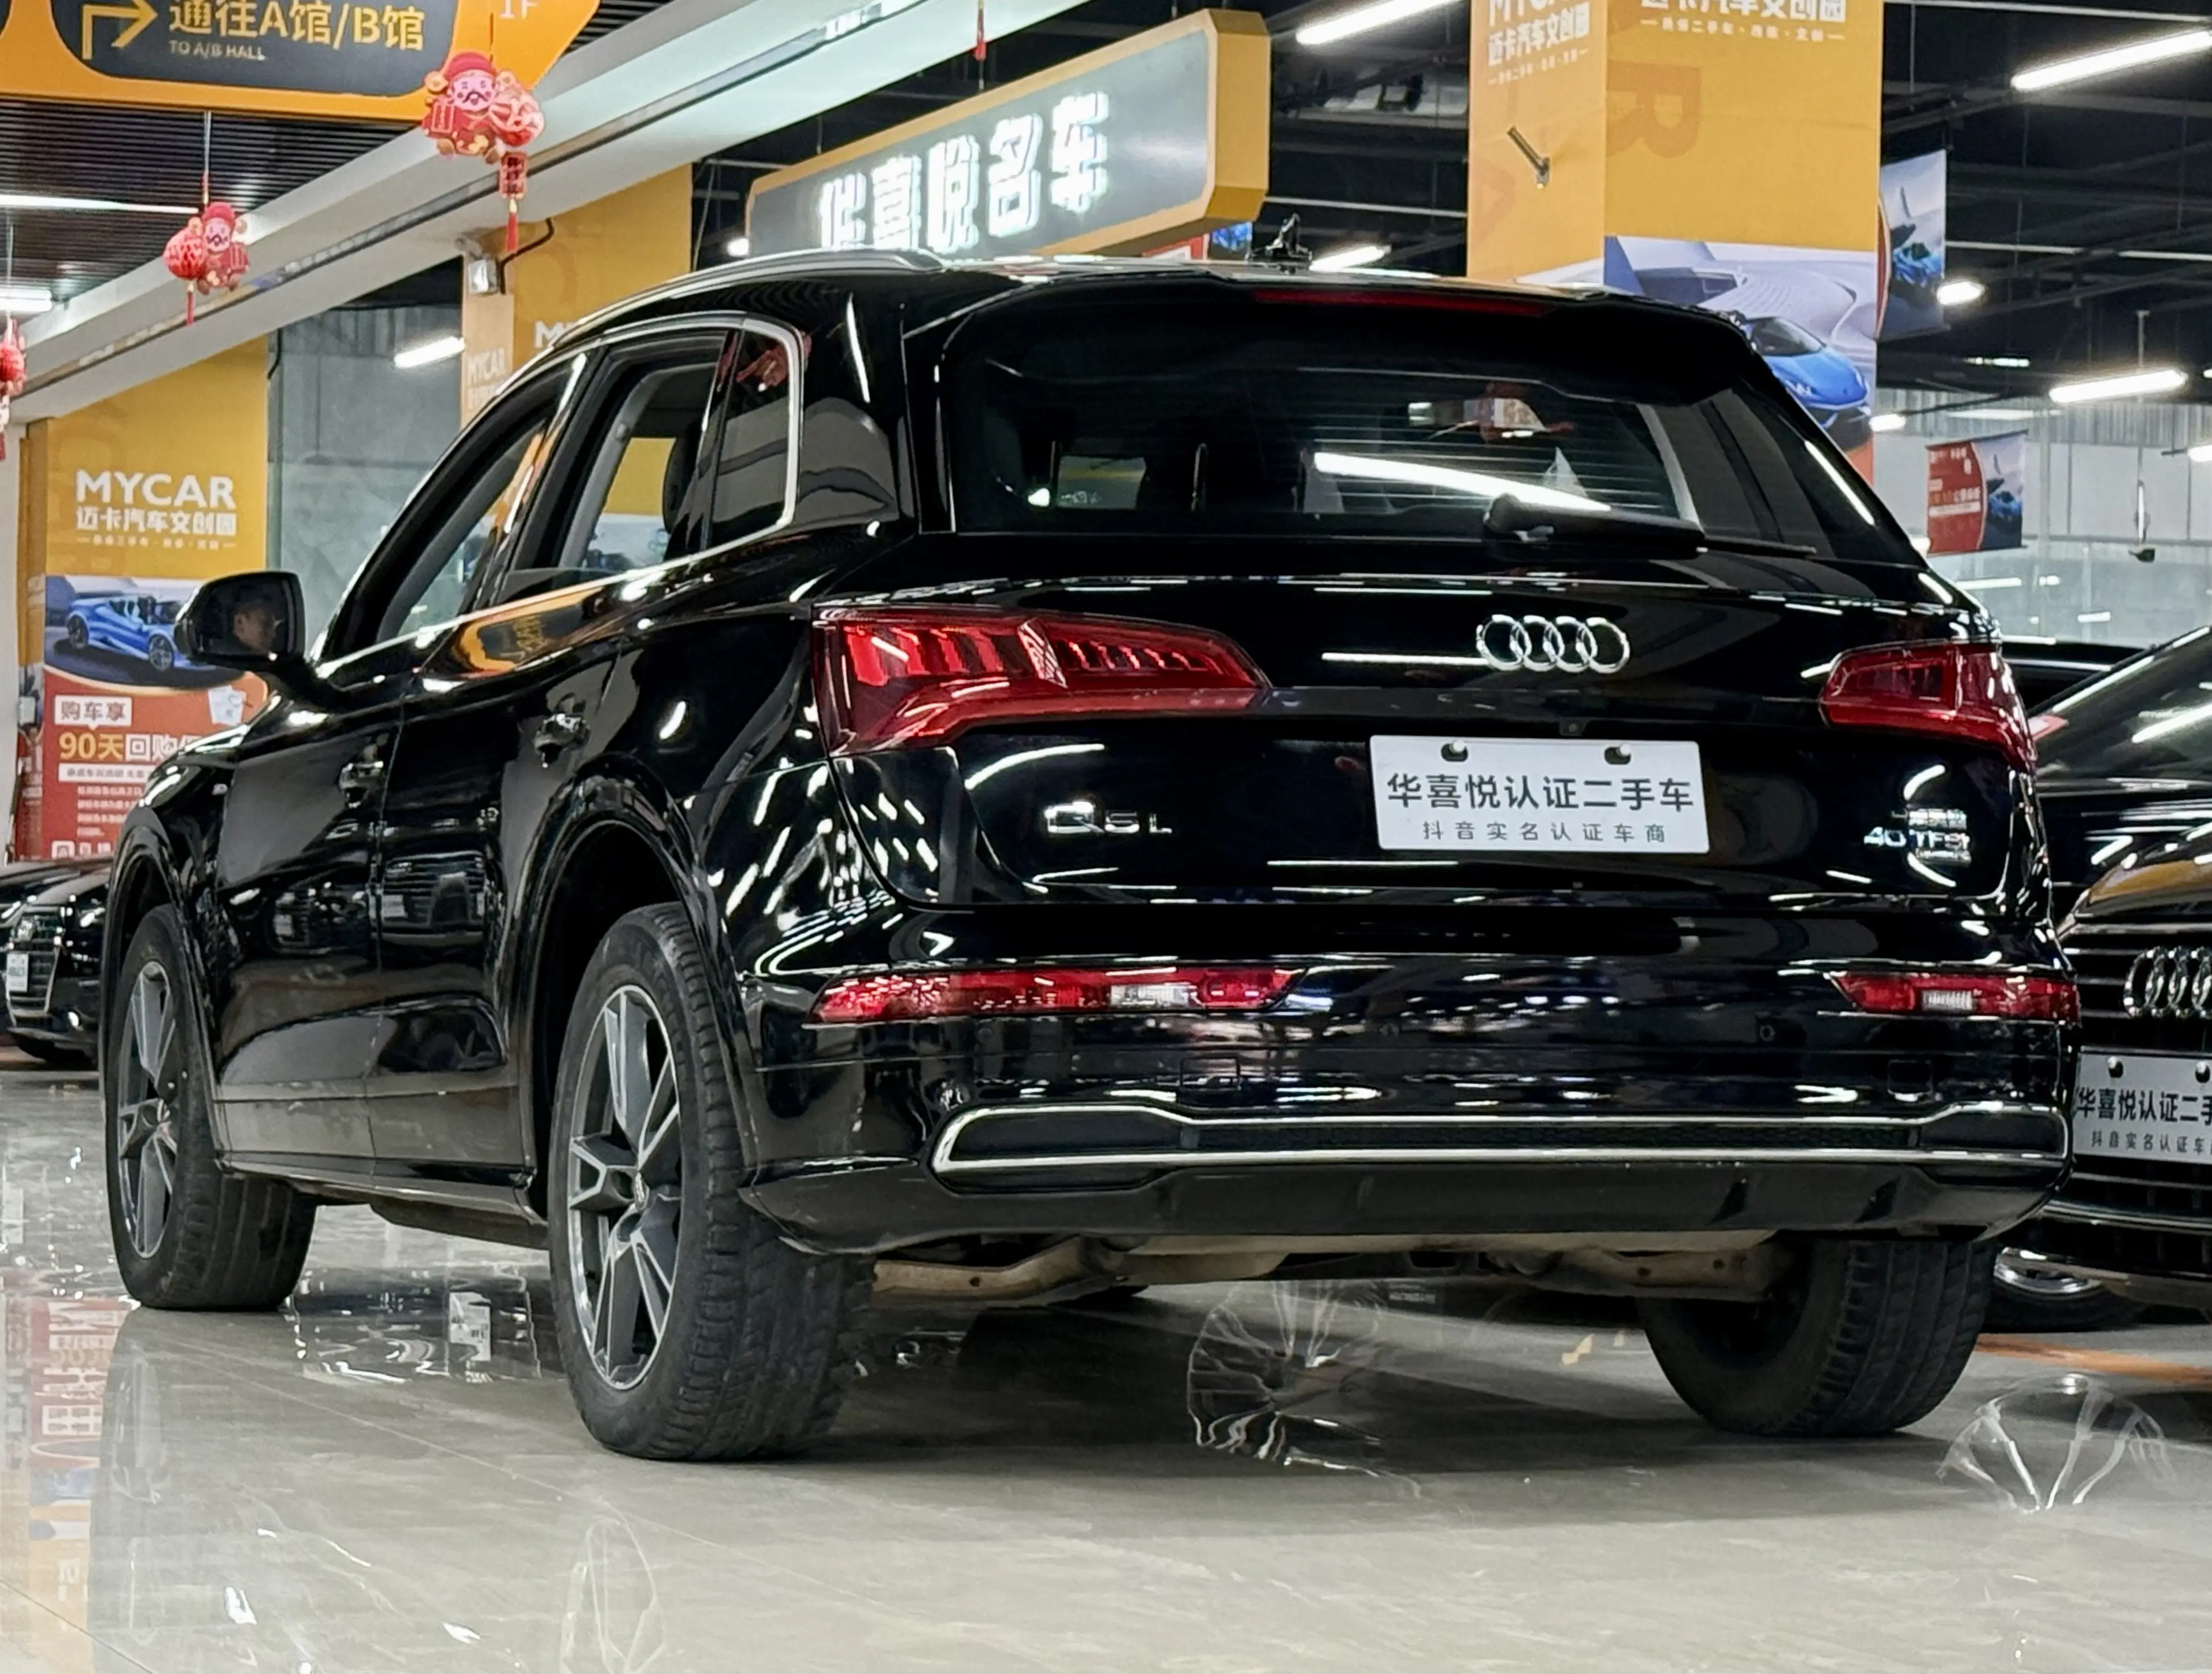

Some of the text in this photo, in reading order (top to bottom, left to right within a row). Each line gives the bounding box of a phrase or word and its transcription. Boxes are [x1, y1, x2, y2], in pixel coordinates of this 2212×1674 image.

[169, 0, 425, 50] 通往A馆/B馆
[225, 47, 266, 61] HALL
[76, 469, 236, 509] MYCAR
[61, 702, 126, 721] 购车享
[1387, 773, 1694, 812] 华喜悦认证二手车
[1422, 820, 1665, 843] 抖音实名认证车商
[2092, 1130, 2212, 1155] 抖音实名认证车
